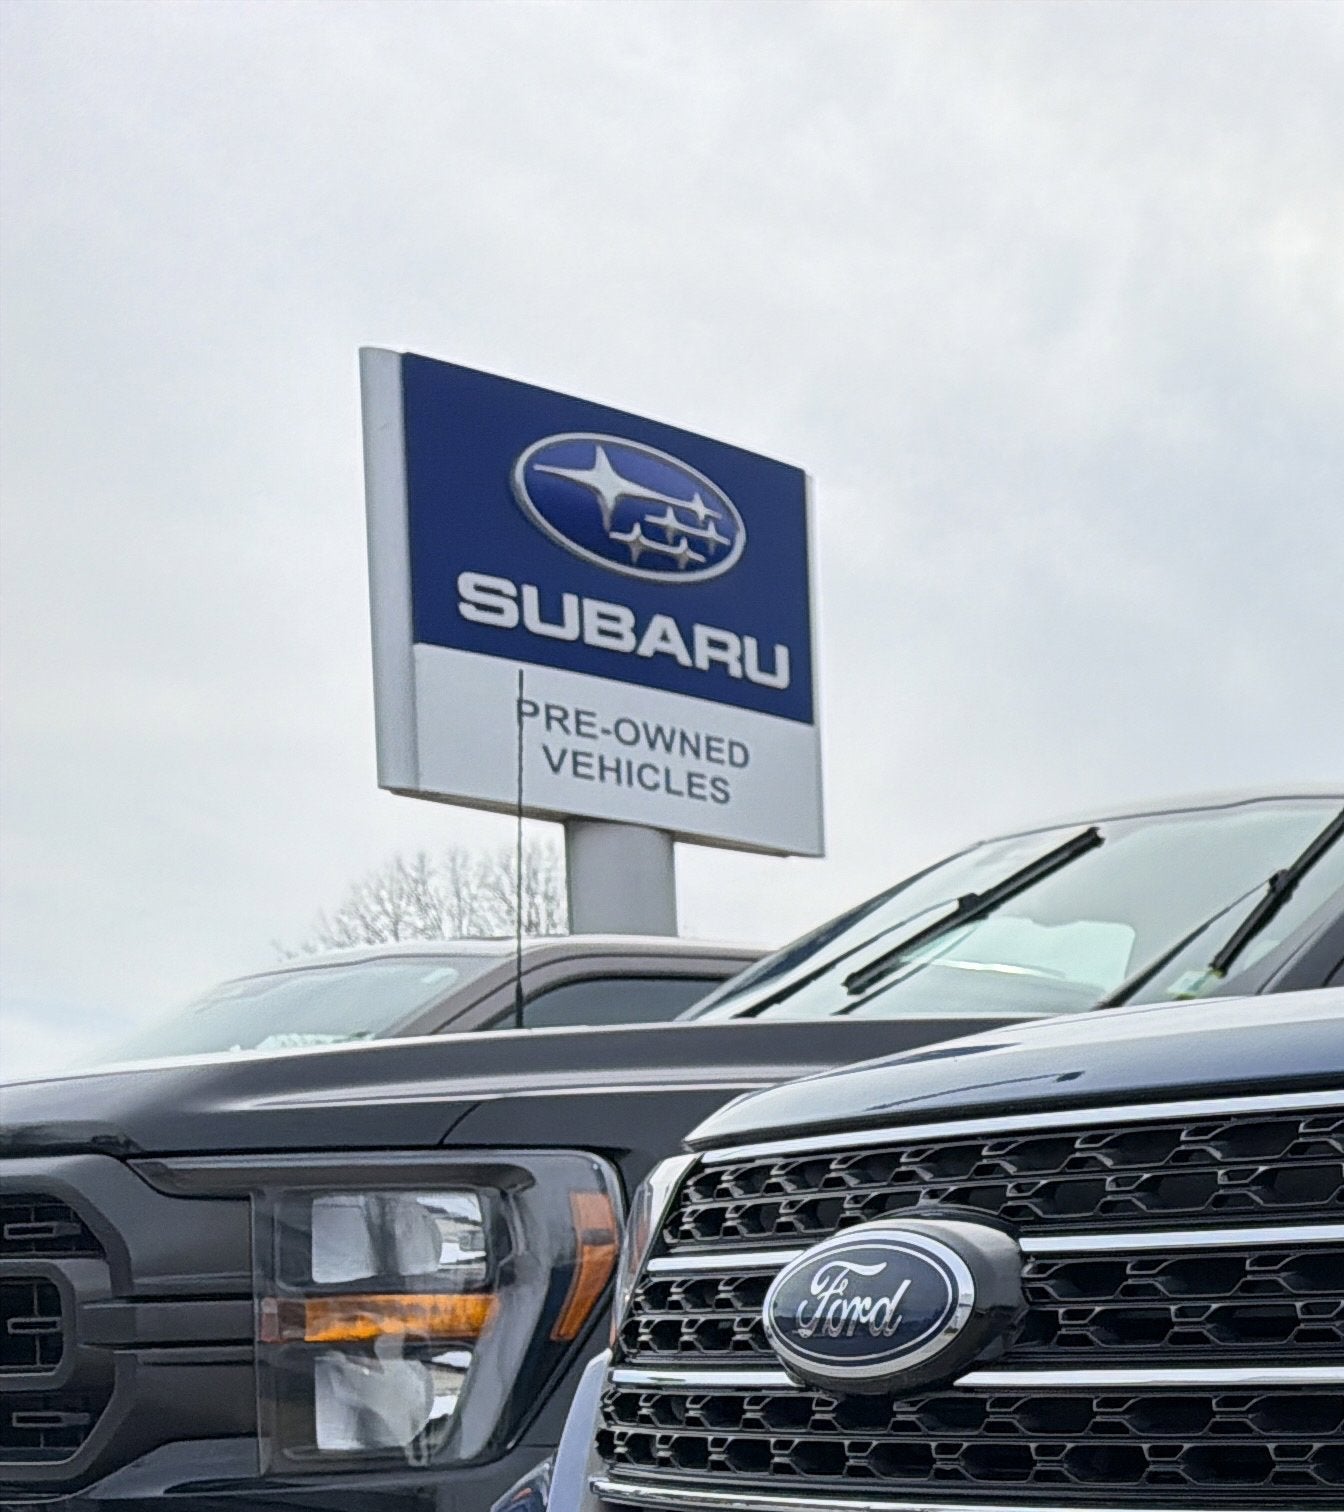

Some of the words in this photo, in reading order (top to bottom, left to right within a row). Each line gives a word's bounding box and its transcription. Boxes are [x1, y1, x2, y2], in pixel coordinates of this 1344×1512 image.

[457, 571, 790, 690] SUBARU
[517, 699, 750, 769] PRE-OWNED
[543, 743, 731, 804] VEHICLES
[797, 1261, 912, 1338] Ford
